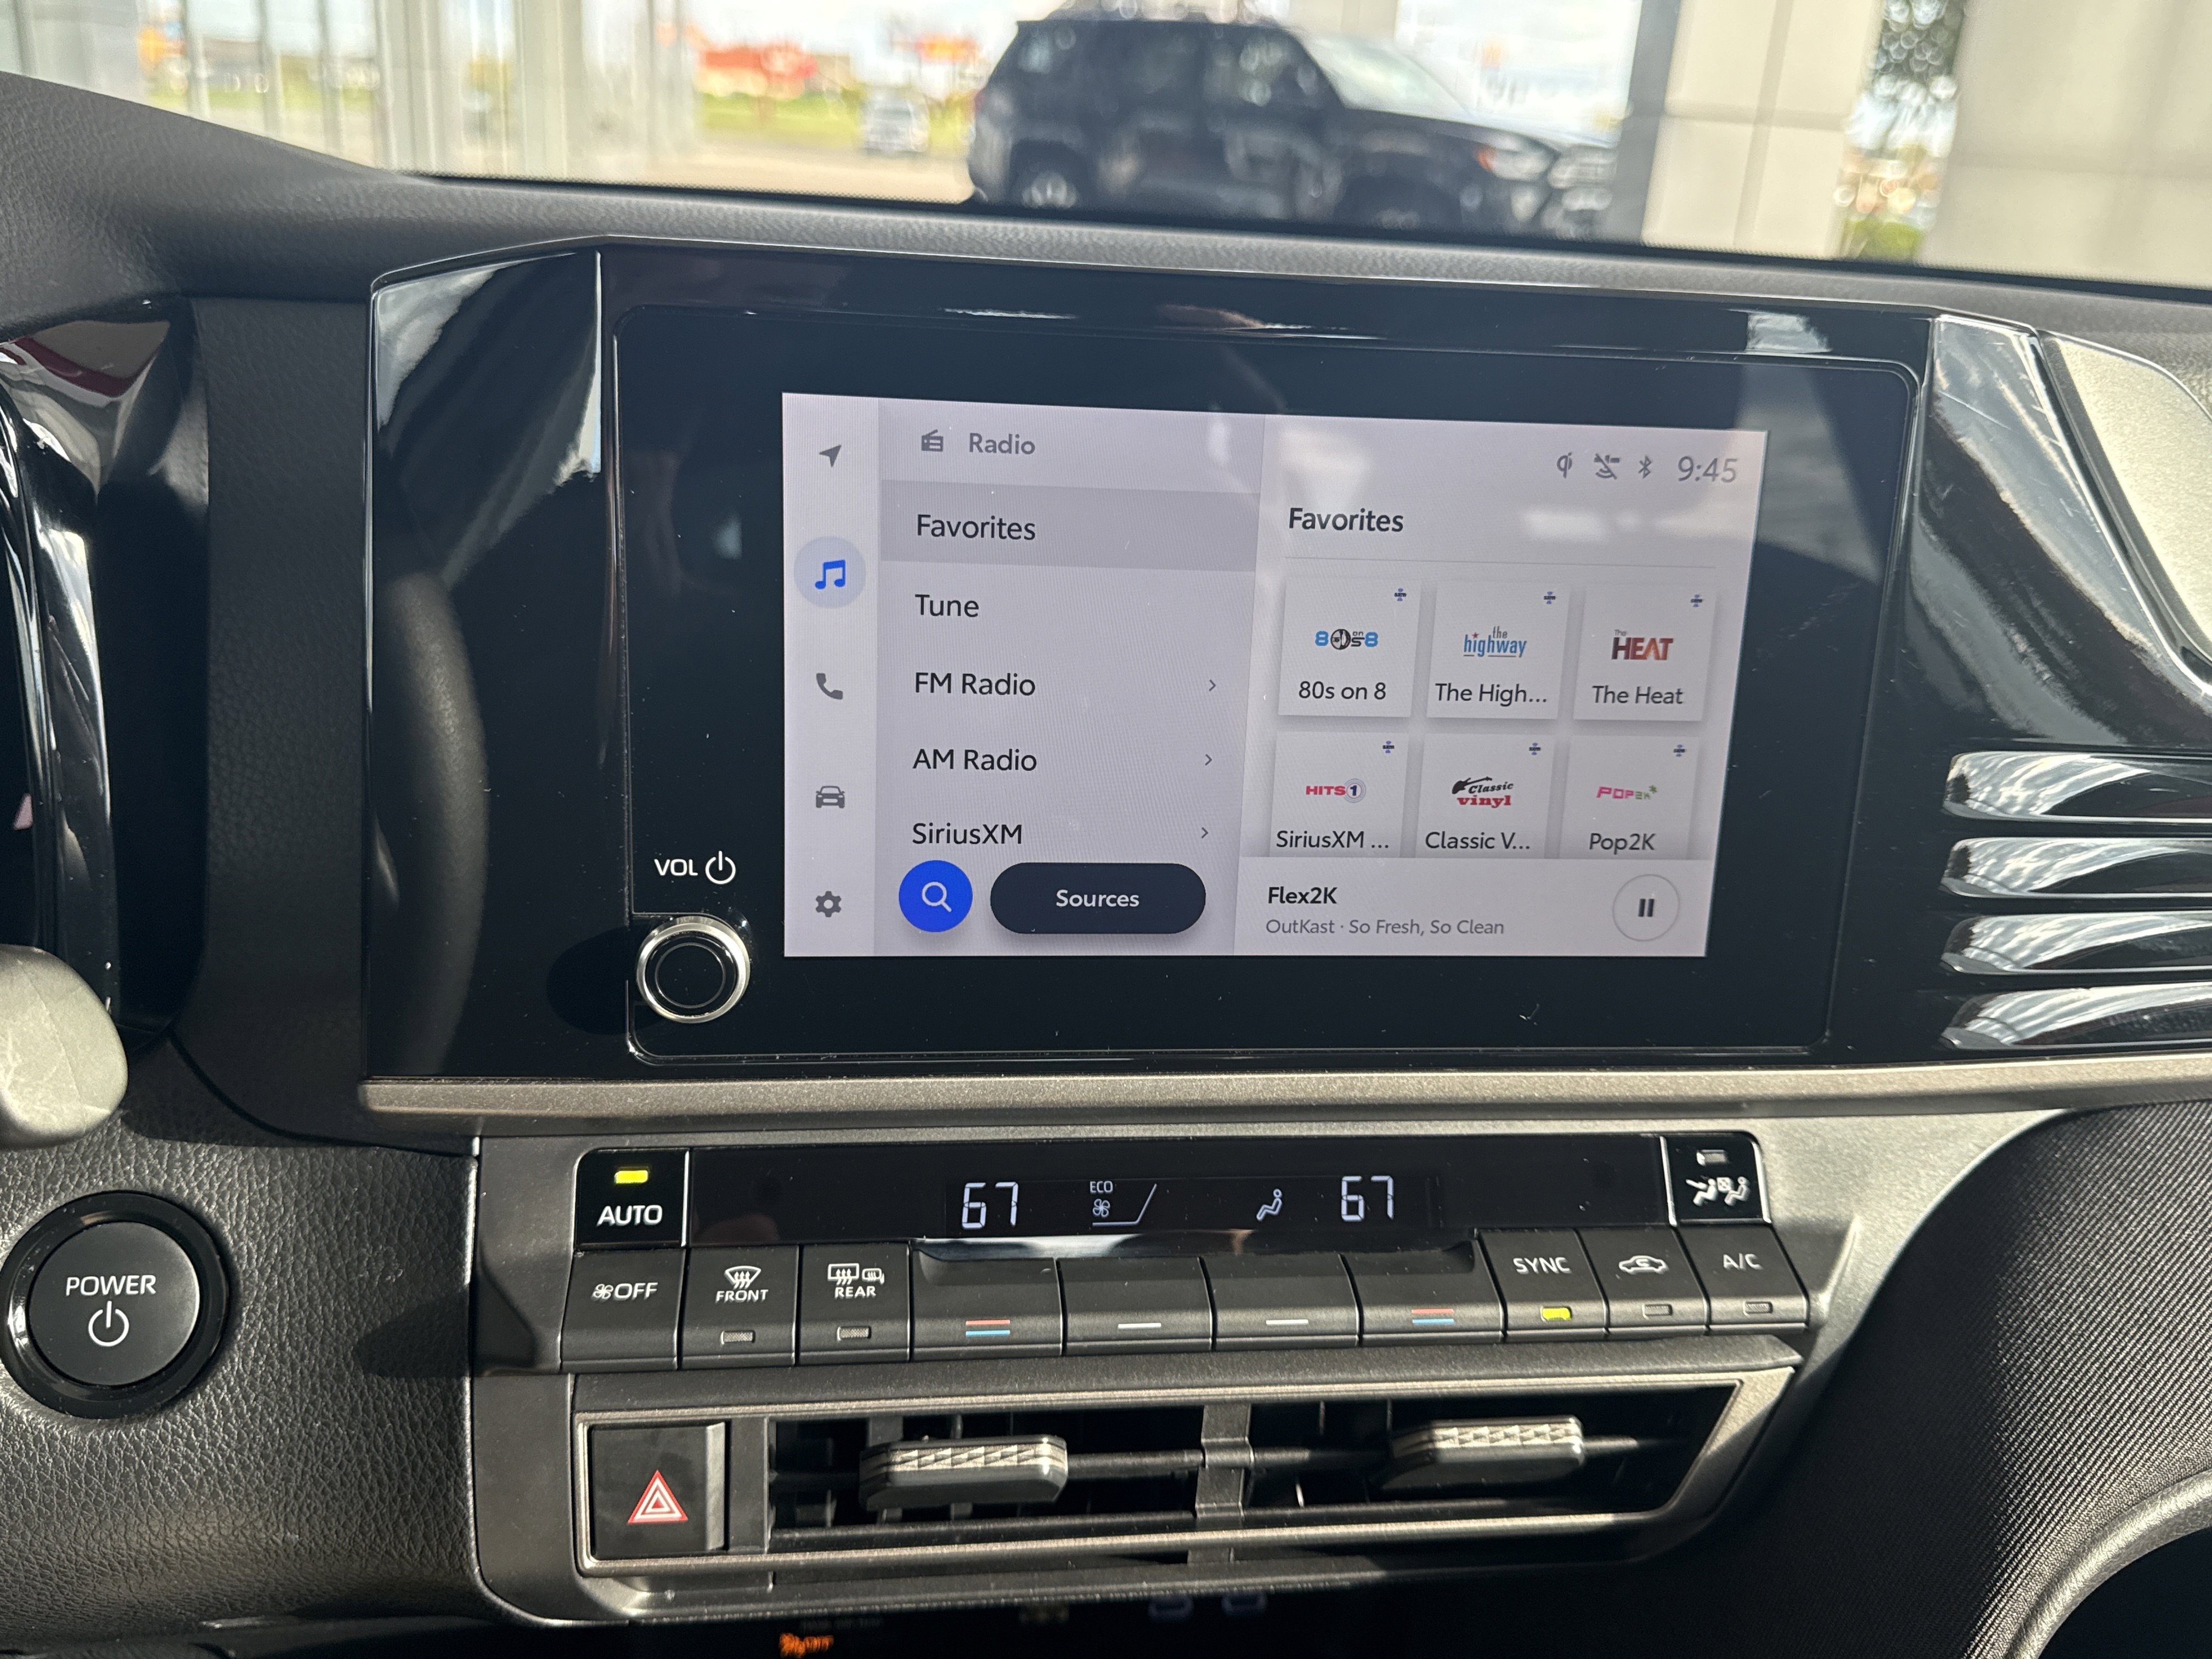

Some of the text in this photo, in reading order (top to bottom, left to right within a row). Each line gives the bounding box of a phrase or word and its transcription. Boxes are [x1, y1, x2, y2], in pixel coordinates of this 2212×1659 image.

[969, 432, 1036, 455] Radio
[1678, 455, 1736, 482] 9:45
[917, 514, 1036, 540] Favorites
[1289, 507, 1403, 532] Favorites
[915, 594, 979, 618] Tune
[1463, 634, 1527, 658] highway
[1611, 637, 1674, 661] HEAT
[915, 672, 1036, 696] FM Radio
[1299, 681, 1386, 700] 80s on 8
[1435, 682, 1472, 701] The
[1592, 685, 1683, 704] The Heat
[912, 748, 1037, 771] AM Radio
[1468, 781, 1514, 794] Classic
[1457, 794, 1511, 809] vinyl
[912, 822, 1022, 845] SiriusXM
[1276, 830, 1364, 848] SiriusXM
[1425, 831, 1496, 849] Classic
[1589, 833, 1655, 855] Pop2K
[654, 859, 698, 876] VOL
[1056, 889, 1139, 907] Sources
[1268, 886, 1338, 904] Flex2K
[1266, 919, 1335, 934] OutKast
[1348, 919, 1370, 934] So
[1376, 919, 1424, 936] Fresh,
[1430, 919, 1452, 934] So
[1457, 919, 1504, 934] Clean
[1090, 1181, 1113, 1193] ECO
[962, 1182, 1019, 1229] 67
[1341, 1176, 1393, 1221] 67
[597, 1205, 663, 1226] AUTO
[1513, 1257, 1570, 1273] SYNC
[1723, 1253, 1760, 1269] A/C
[66, 1274, 156, 1296] POWER
[613, 1282, 658, 1300] OFF
[834, 1286, 877, 1298] REAR
[715, 1289, 769, 1302] FRONT
